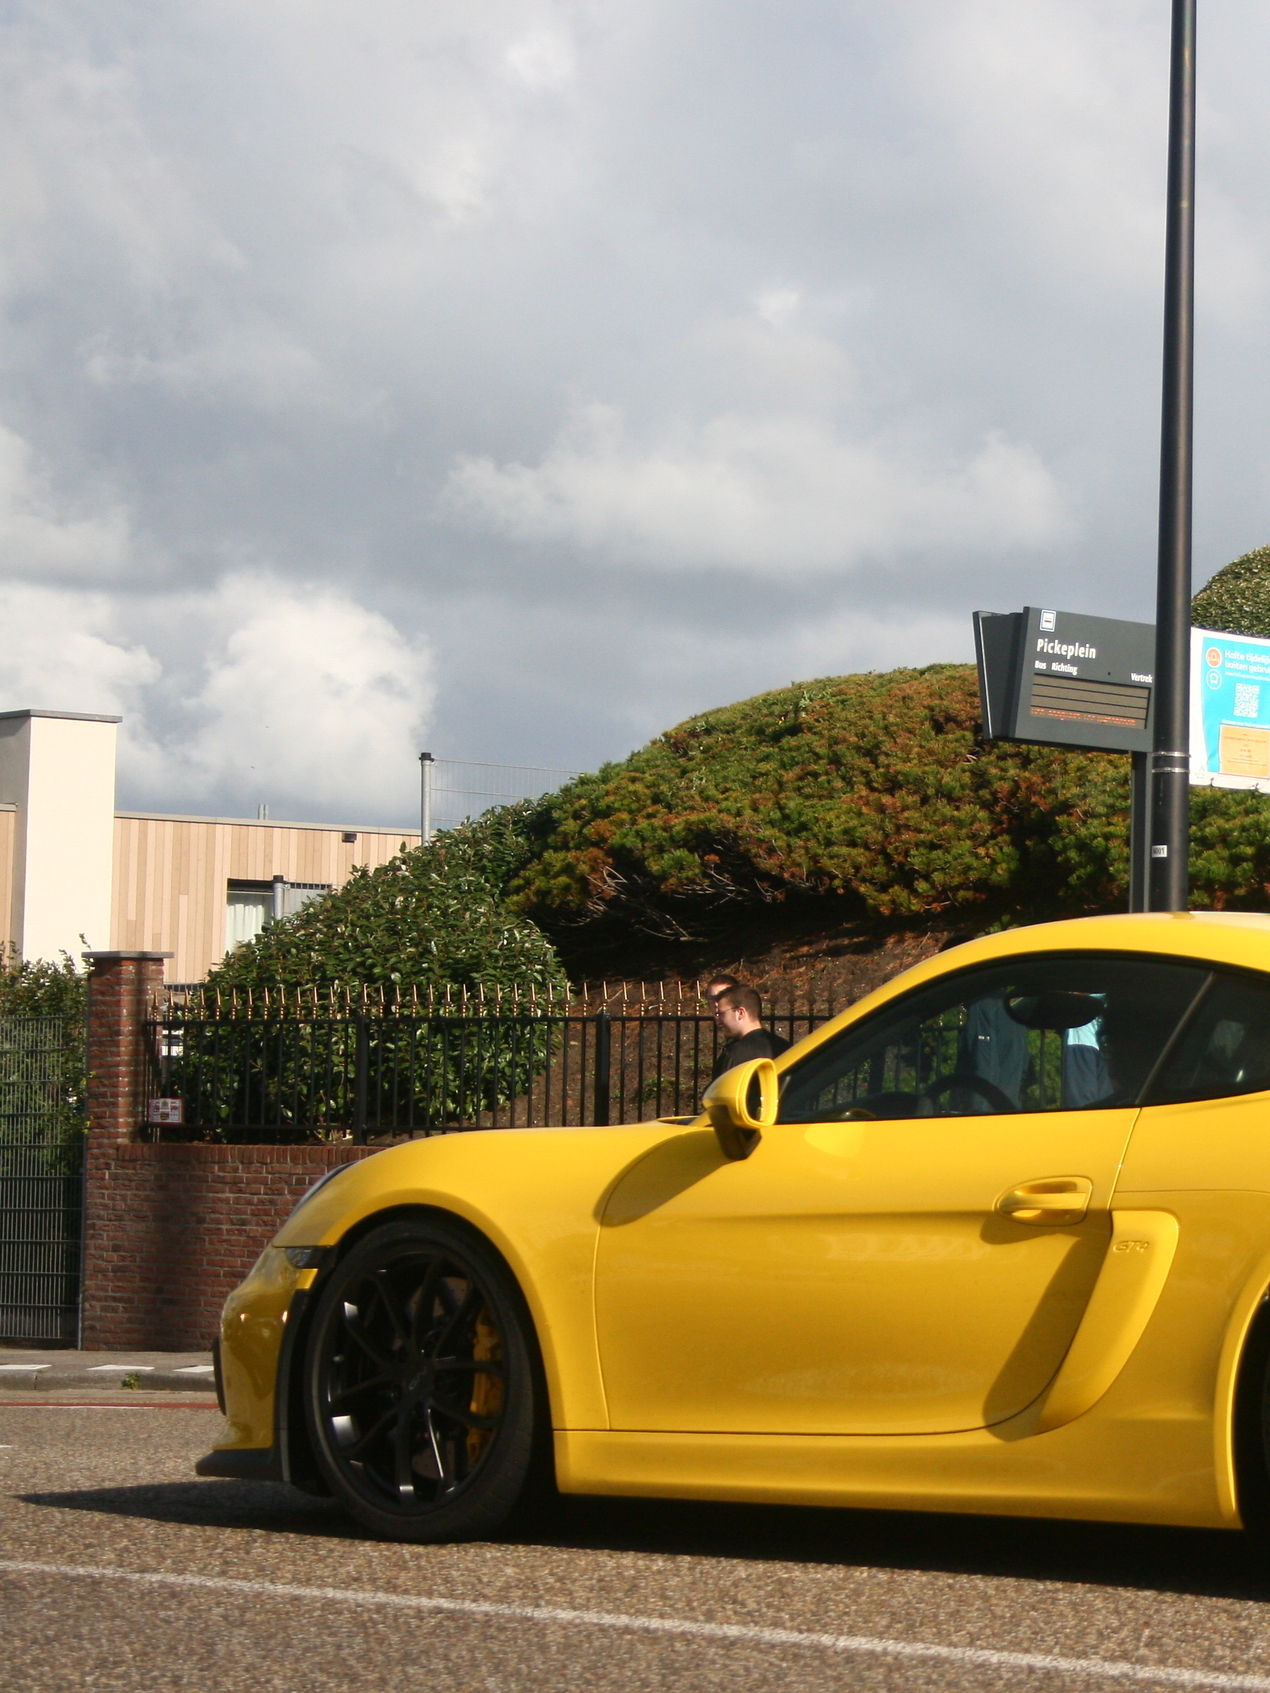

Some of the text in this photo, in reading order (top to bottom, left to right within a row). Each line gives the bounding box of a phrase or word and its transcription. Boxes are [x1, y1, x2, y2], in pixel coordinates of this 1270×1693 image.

[1036, 638, 1097, 659] Pickeplein
[1224, 650, 1245, 660] Halte
[1034, 660, 1078, 676] Bus Richting
[1224, 661, 1248, 670] buiten
[1113, 1240, 1149, 1253] GT4
